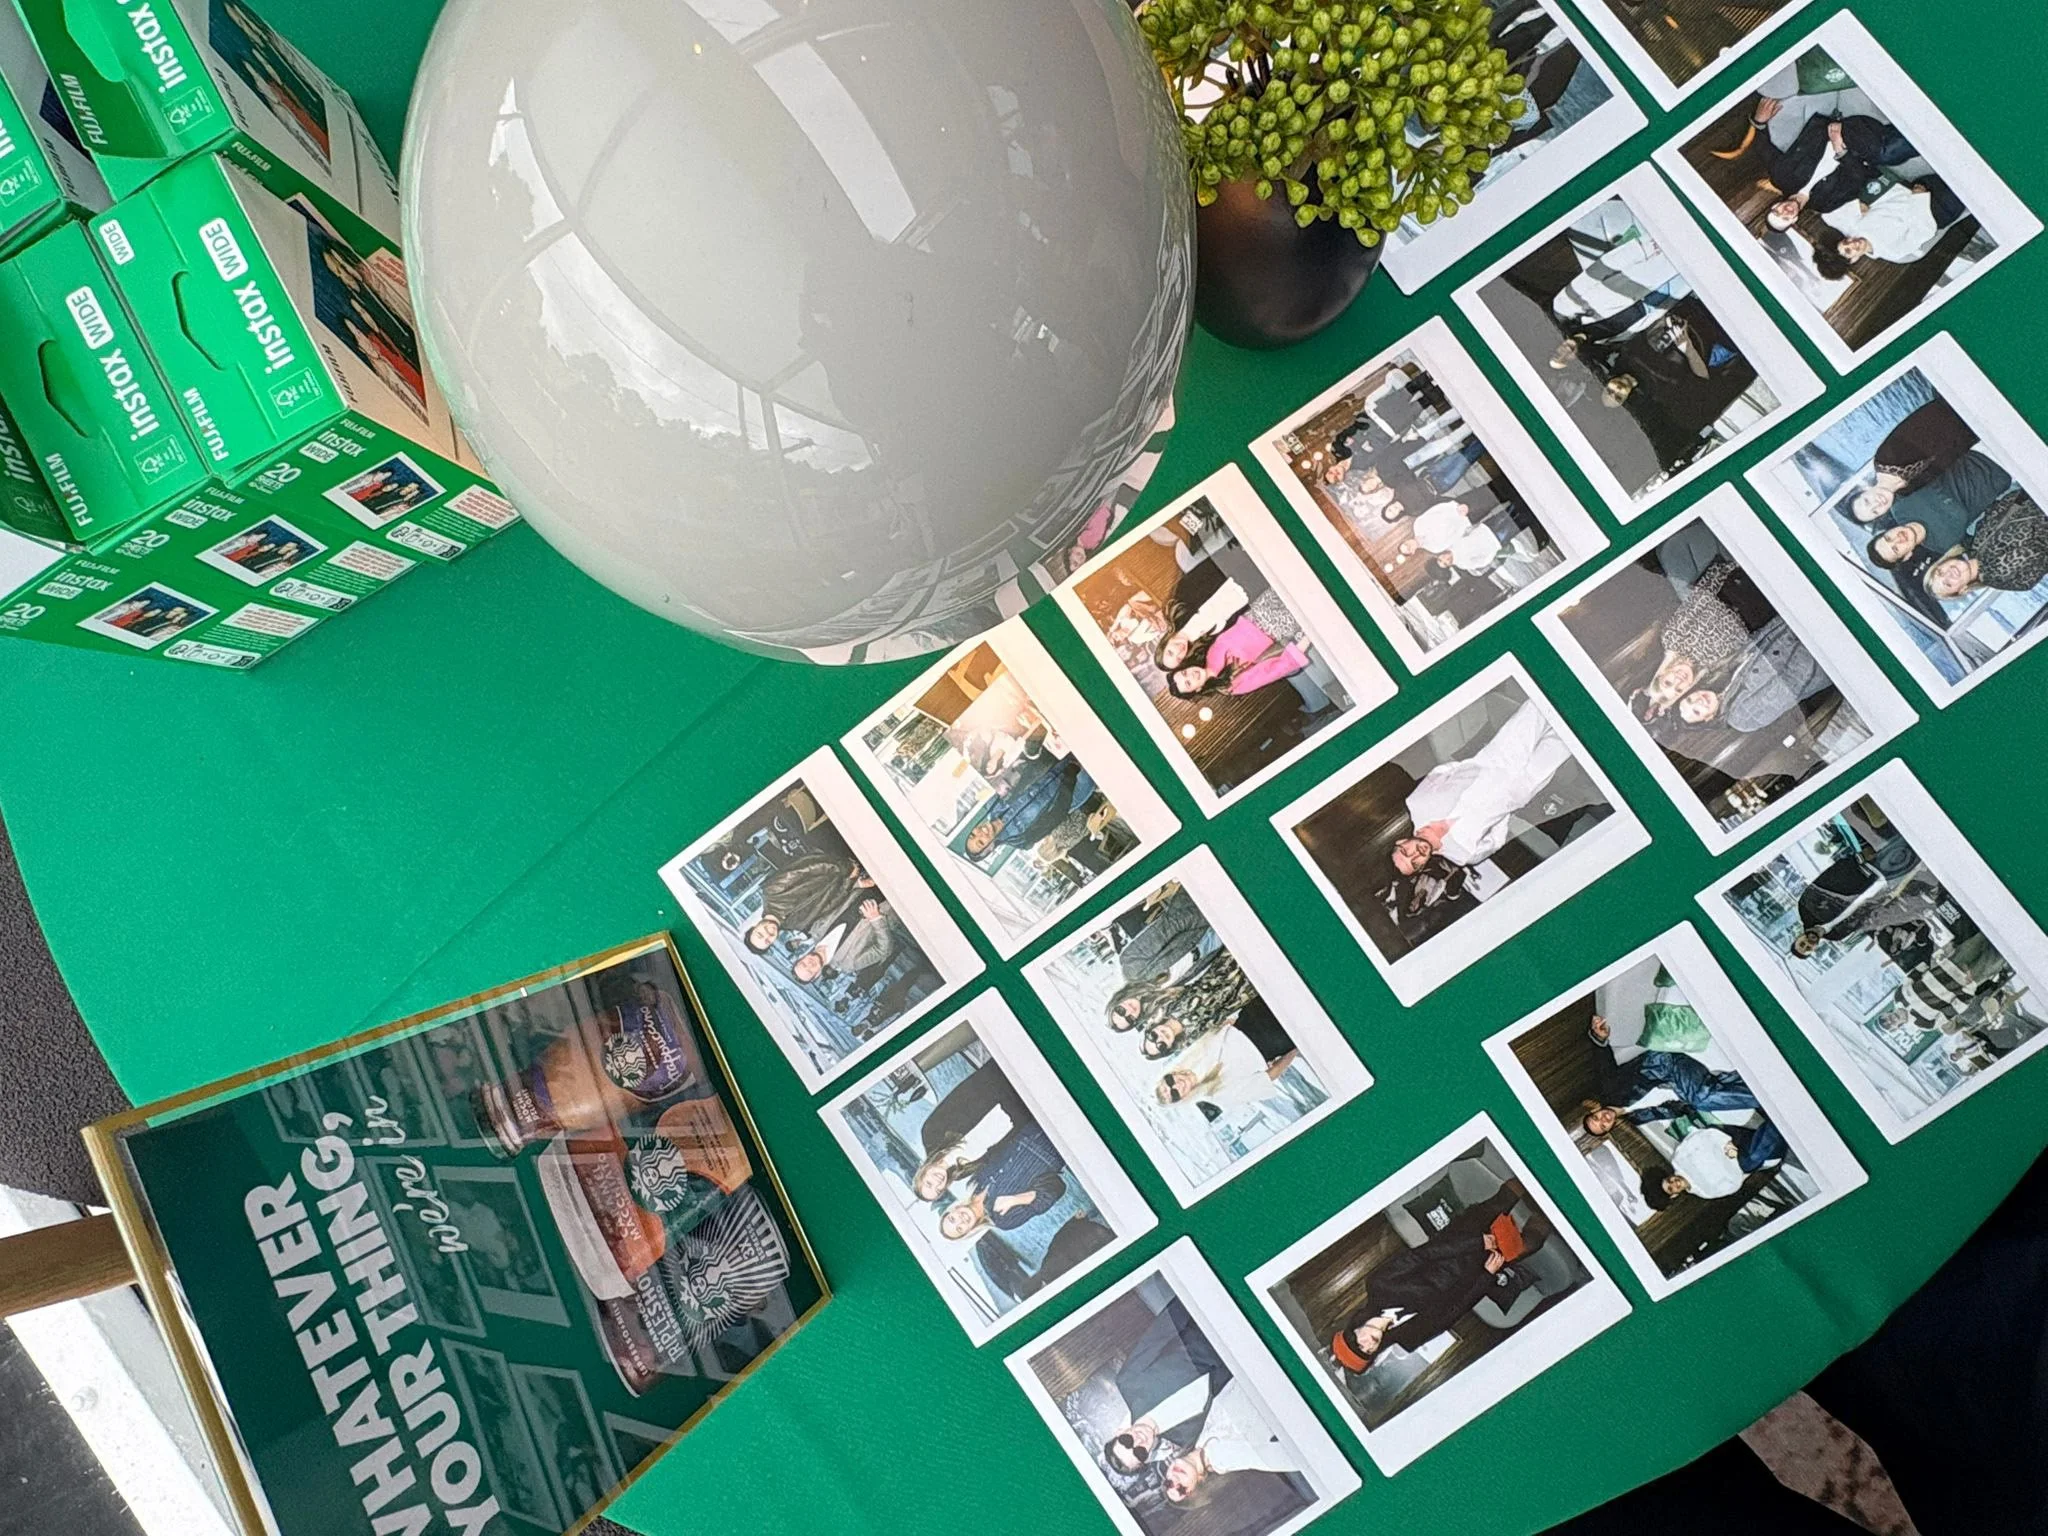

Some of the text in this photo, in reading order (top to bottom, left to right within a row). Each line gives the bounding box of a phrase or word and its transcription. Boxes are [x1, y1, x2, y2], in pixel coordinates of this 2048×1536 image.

[127, 3, 188, 94] instax
[60, 73, 108, 145] FUJIFILM
[102, 222, 132, 262] WIDE
[204, 222, 242, 276] WIDE
[72, 291, 109, 344] WIDE
[233, 280, 295, 375] instax
[100, 347, 160, 442] instax
[183, 387, 230, 462] FUJIFILM
[317, 428, 367, 458] instax
[264, 462, 302, 483] 20
[303, 443, 338, 462] WIDE
[45, 452, 94, 527] FUJIFILM
[182, 496, 238, 523] instax
[131, 529, 170, 548] 20
[170, 510, 206, 527] WIDE
[53, 568, 114, 592] instax
[4, 602, 46, 619] 20
[362, 1095, 468, 1252] we're in
[300, 1112, 500, 1536] YOUR THING,
